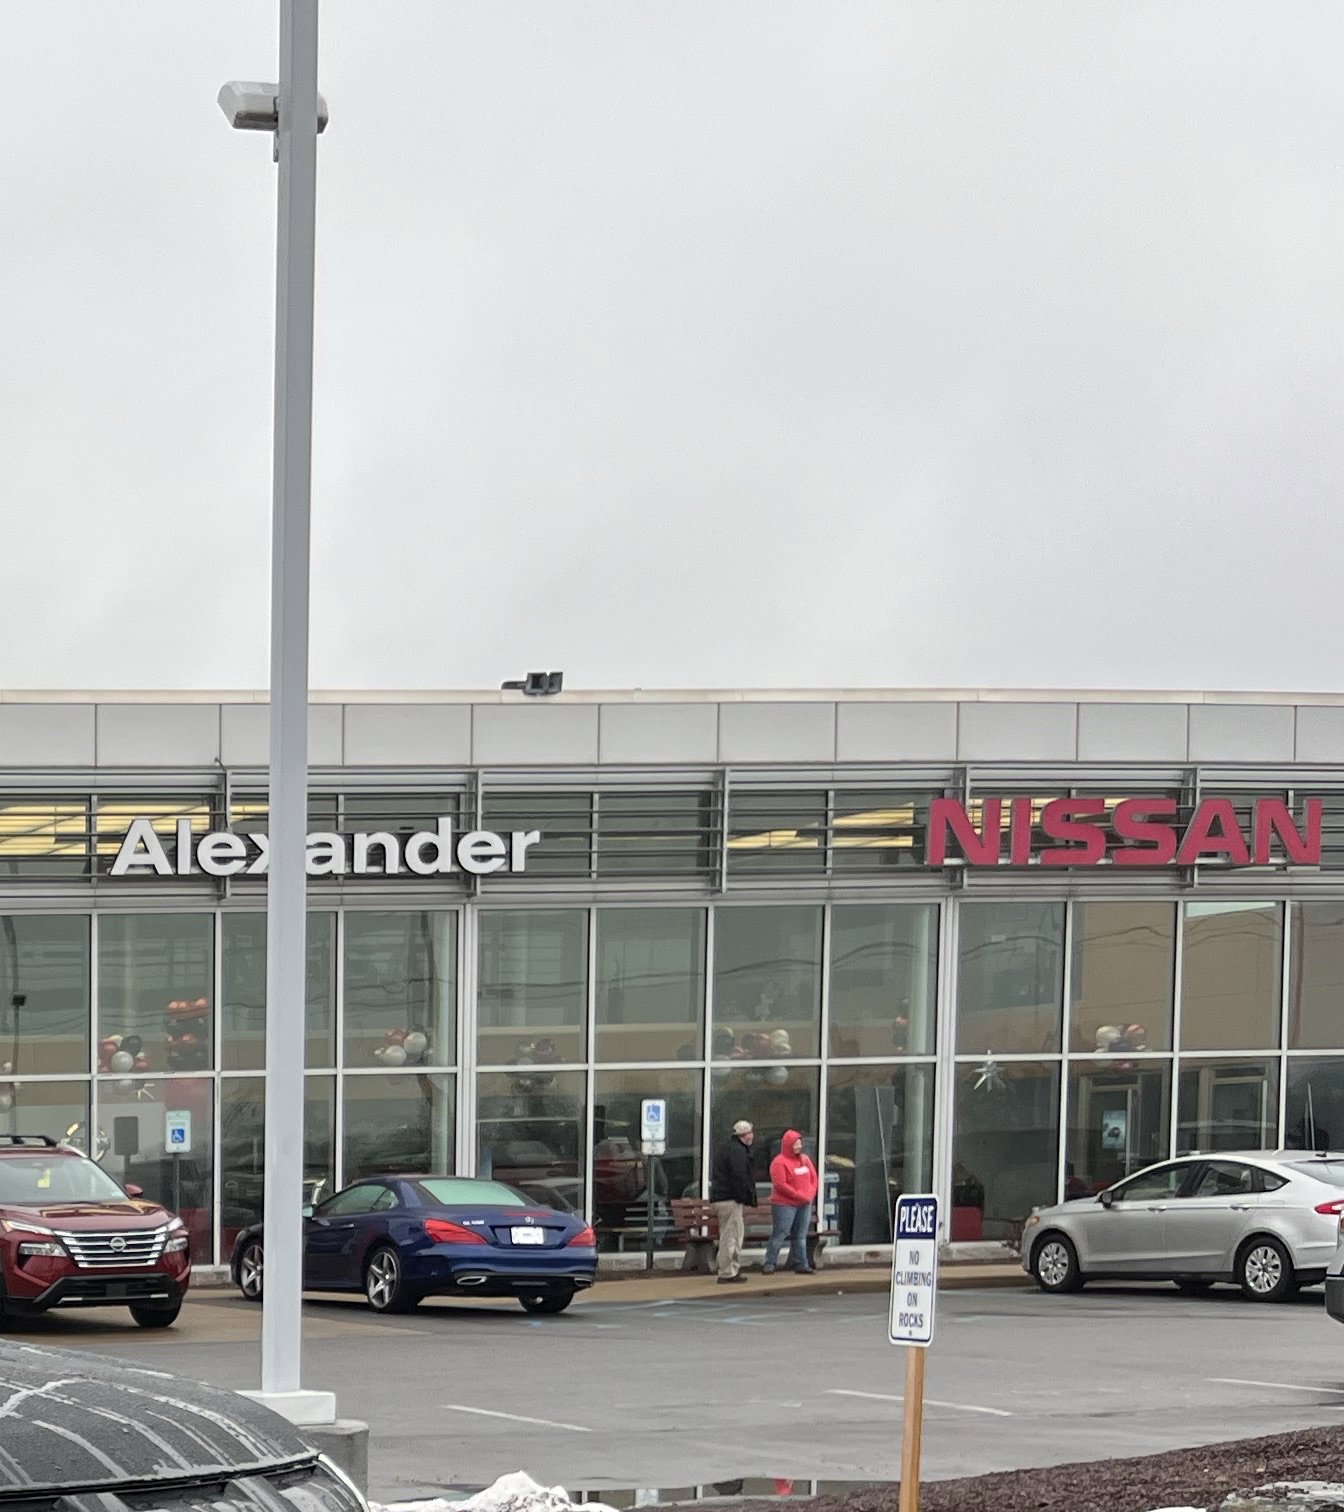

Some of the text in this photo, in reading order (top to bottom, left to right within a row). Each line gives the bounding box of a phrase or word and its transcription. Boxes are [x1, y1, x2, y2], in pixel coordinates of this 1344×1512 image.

[925, 797, 1323, 866] NISSAN
[899, 1205, 934, 1233] PLEASE
[909, 1250, 920, 1265] NO
[896, 1271, 932, 1287] CLIMBING
[907, 1292, 918, 1307] ON
[899, 1313, 924, 1329] ROCKS
